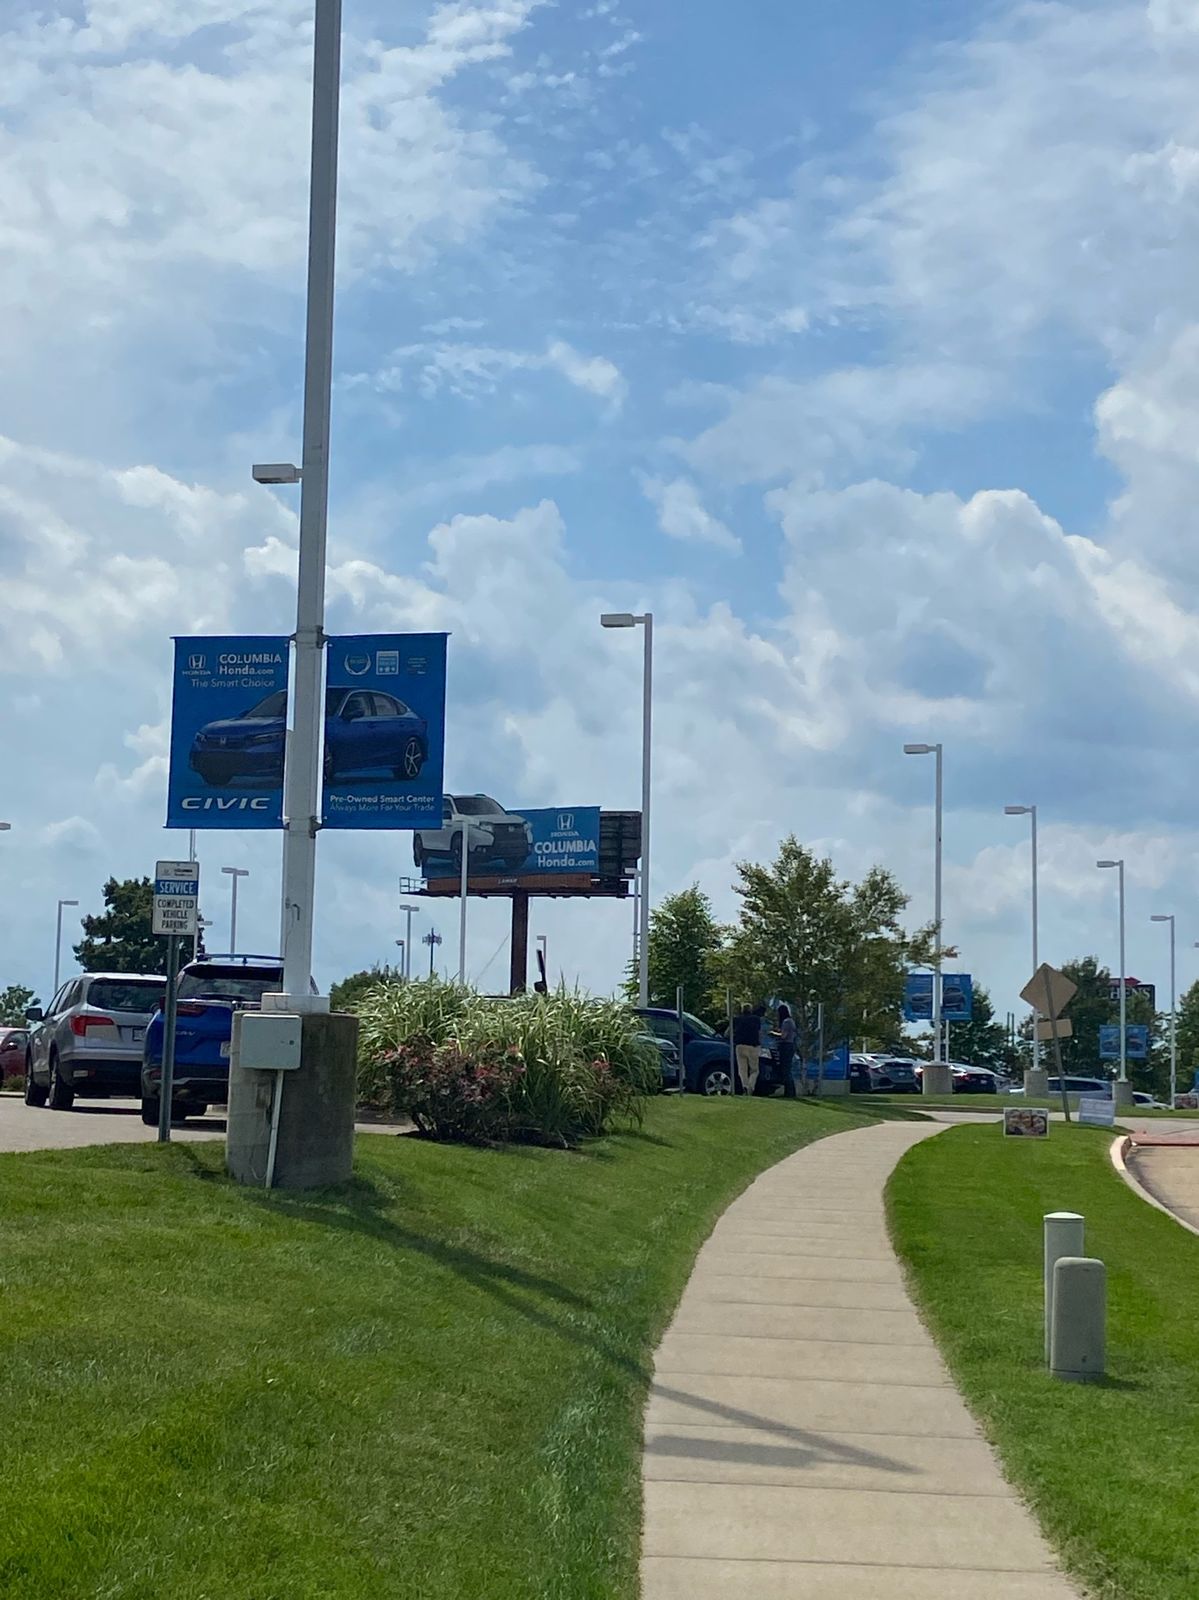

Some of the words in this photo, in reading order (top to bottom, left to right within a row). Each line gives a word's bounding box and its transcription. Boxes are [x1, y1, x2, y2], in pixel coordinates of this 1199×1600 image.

[219, 654, 282, 664] COLUMBIA
[219, 665, 274, 675] Honda.com
[191, 679, 208, 688] The
[211, 678, 238, 688] Smart
[241, 678, 275, 688] Choice
[181, 797, 271, 810] CIVIC
[329, 795, 378, 803] Pre-Owned
[380, 795, 405, 803] Smart
[406, 795, 435, 803] Center
[329, 804, 357, 812] Always
[413, 803, 435, 811] Trade
[534, 839, 597, 854] COLUMBIA
[537, 854, 595, 867] Honda.com
[159, 881, 194, 894] SERVICE
[157, 899, 195, 909] COMPLETED
[162, 910, 188, 919] VEHICLE
[161, 919, 188, 929] PARKING
